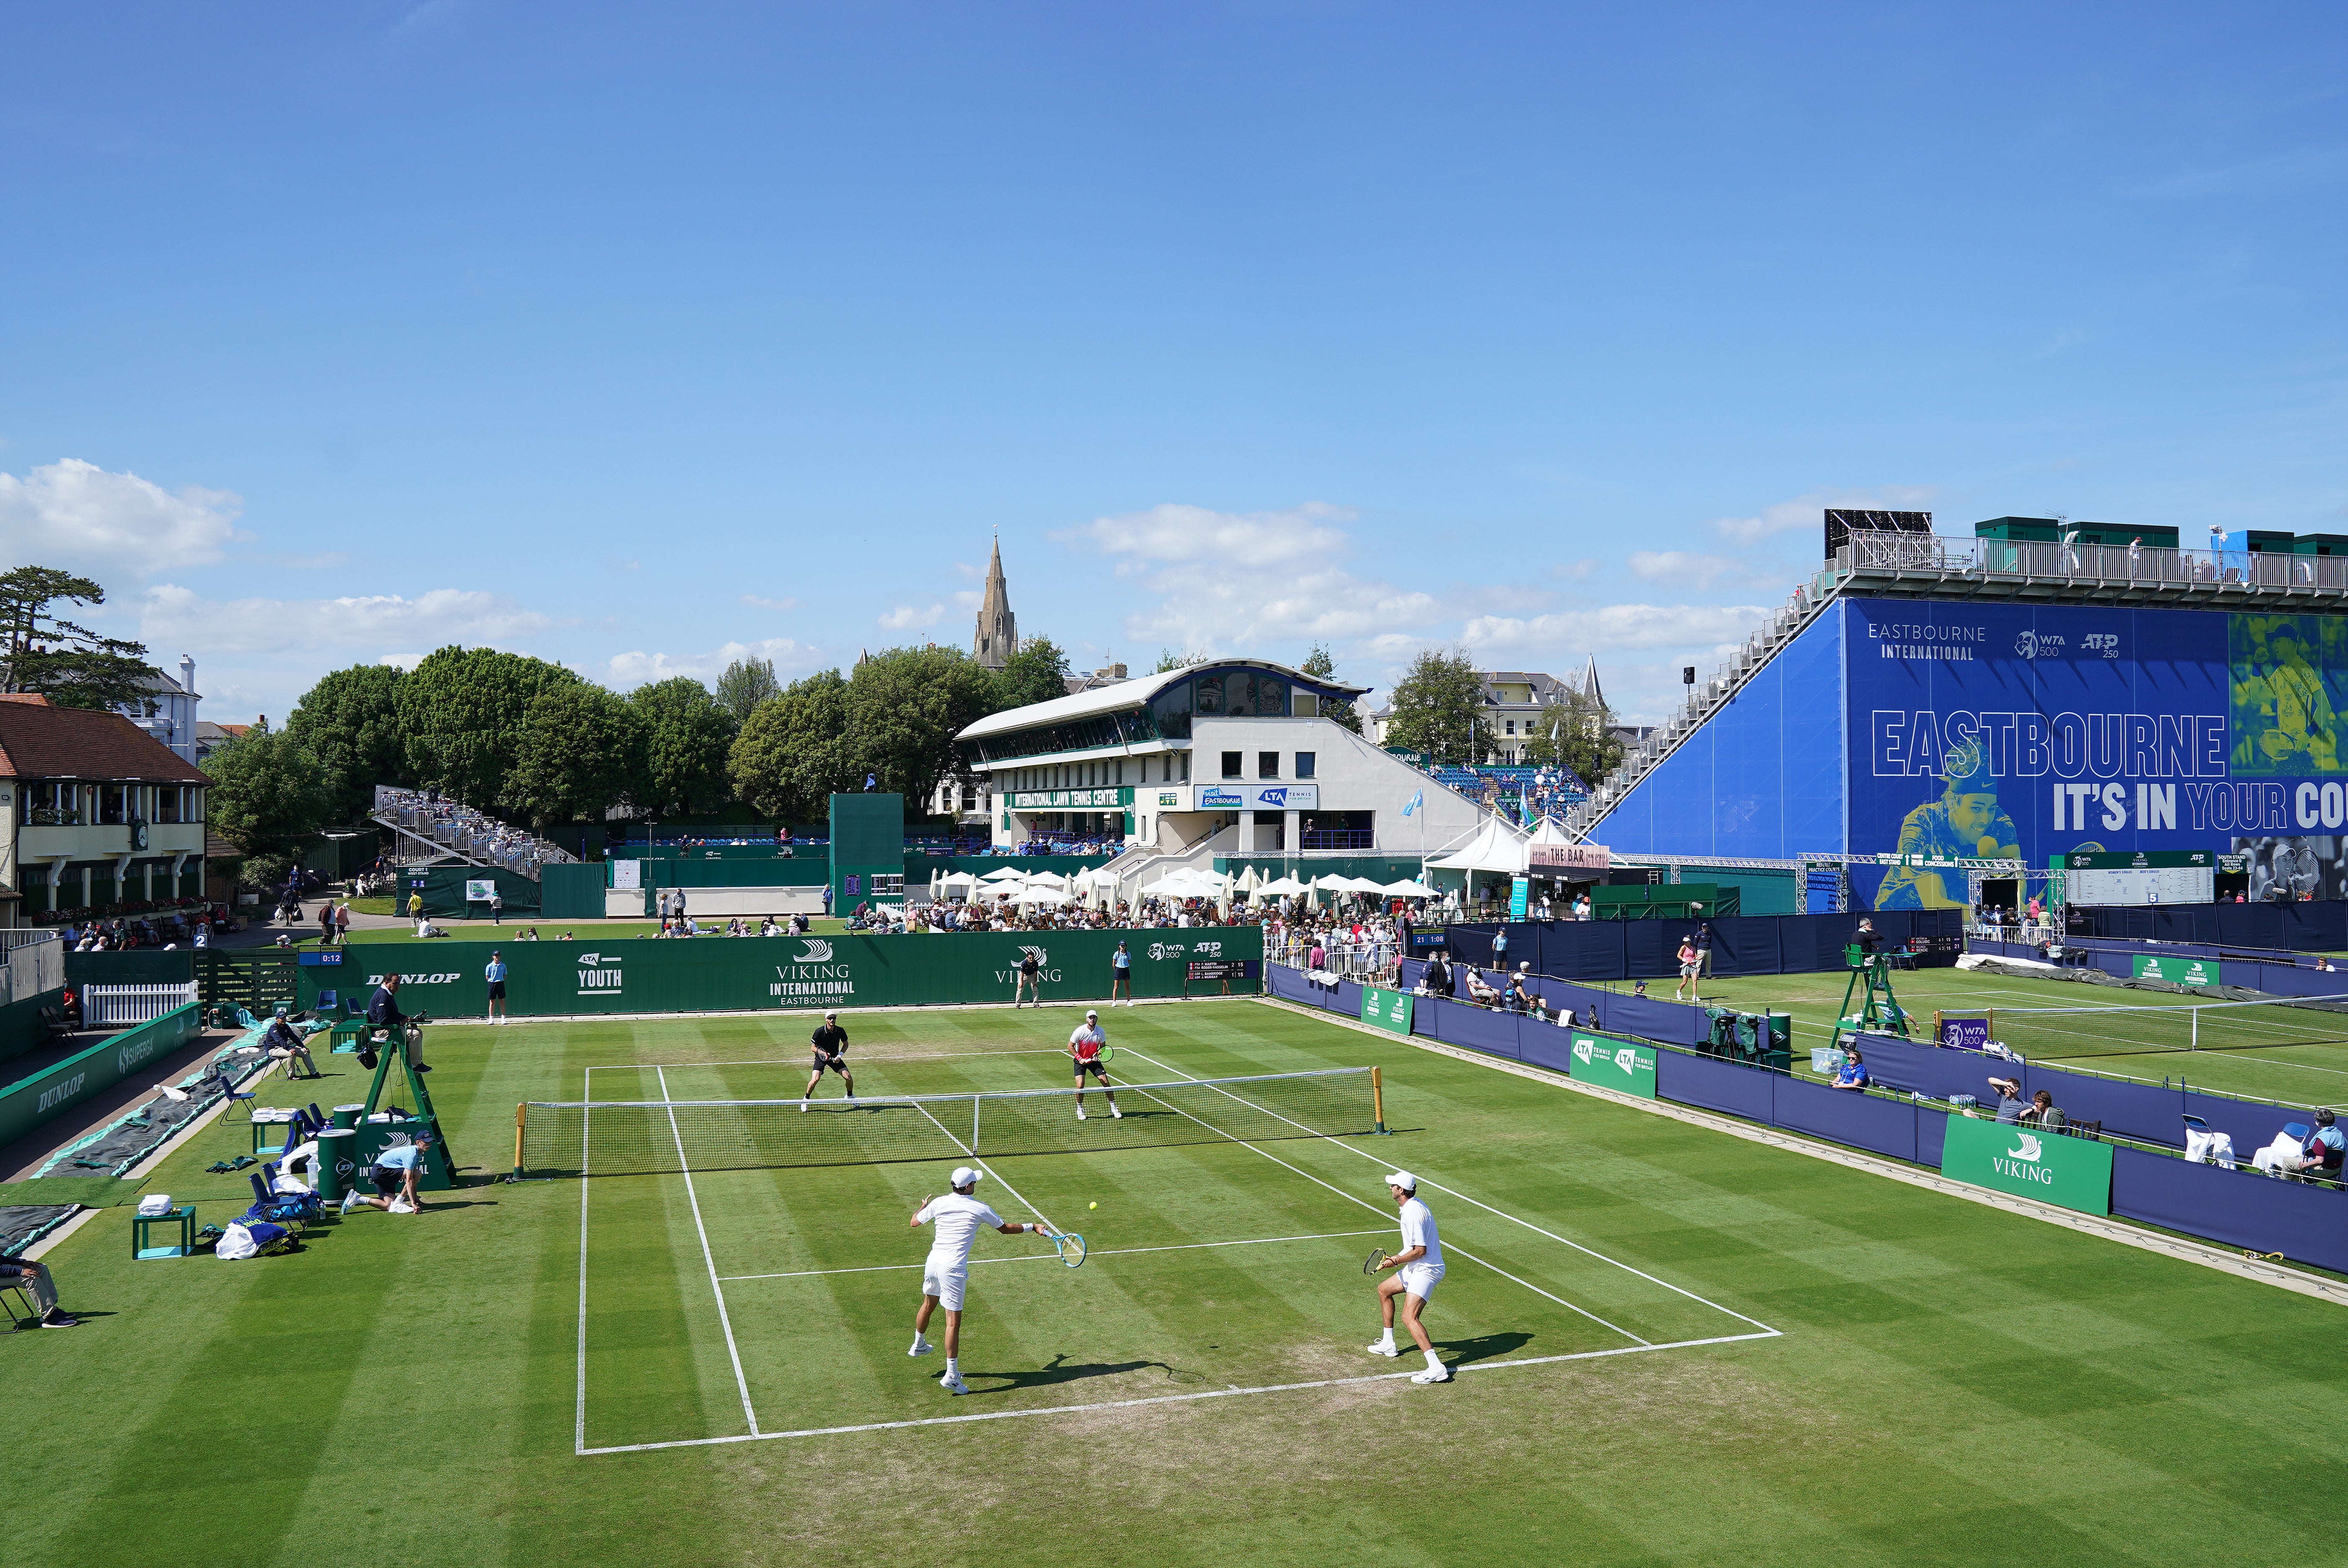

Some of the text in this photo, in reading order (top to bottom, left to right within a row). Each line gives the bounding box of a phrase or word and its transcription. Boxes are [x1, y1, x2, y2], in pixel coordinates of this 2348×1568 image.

[1869, 623, 1986, 641] EASTBOURNE
[2040, 635, 2065, 645] WTA
[2079, 634, 2118, 649] ATP
[1882, 644, 1973, 660] INTERNATIONAL
[2040, 647, 2059, 657] 500
[2103, 649, 2118, 658] 250
[1872, 710, 2226, 778] EASTBOURNE
[1015, 789, 1118, 807] INTERNATIONAL LAWN TENNIS CENTRE
[1265, 792, 1285, 802] LTA
[2137, 783, 2176, 831] IN
[2185, 782, 2287, 831] YOUR
[2296, 782, 2348, 829] CO
[1551, 849, 1564, 861] THE
[1568, 849, 1584, 862] BAR
[2149, 893, 2156, 902] 5
[1536, 908, 1544, 918] 4
[196, 936, 204, 947] 2
[1192, 942, 1221, 952] ATP
[366, 973, 461, 985] DNLOP
[577, 969, 621, 987] YOUTH
[775, 964, 849, 980] VIKING
[995, 969, 1062, 983] VING
[770, 981, 855, 996] INTERNATIONAL
[781, 996, 844, 1005] EASTBOURNE
[1964, 1036, 1980, 1045] 500
[129, 1040, 153, 1066] SUPERGA
[1578, 1043, 1591, 1058] LTA
[1593, 1046, 1611, 1056] TENNIS
[1619, 1053, 1632, 1067] LTA
[1635, 1056, 1654, 1066] TENNIS
[37, 1072, 85, 1114] DUNLOP
[1993, 1157, 2052, 1185] VIKING
